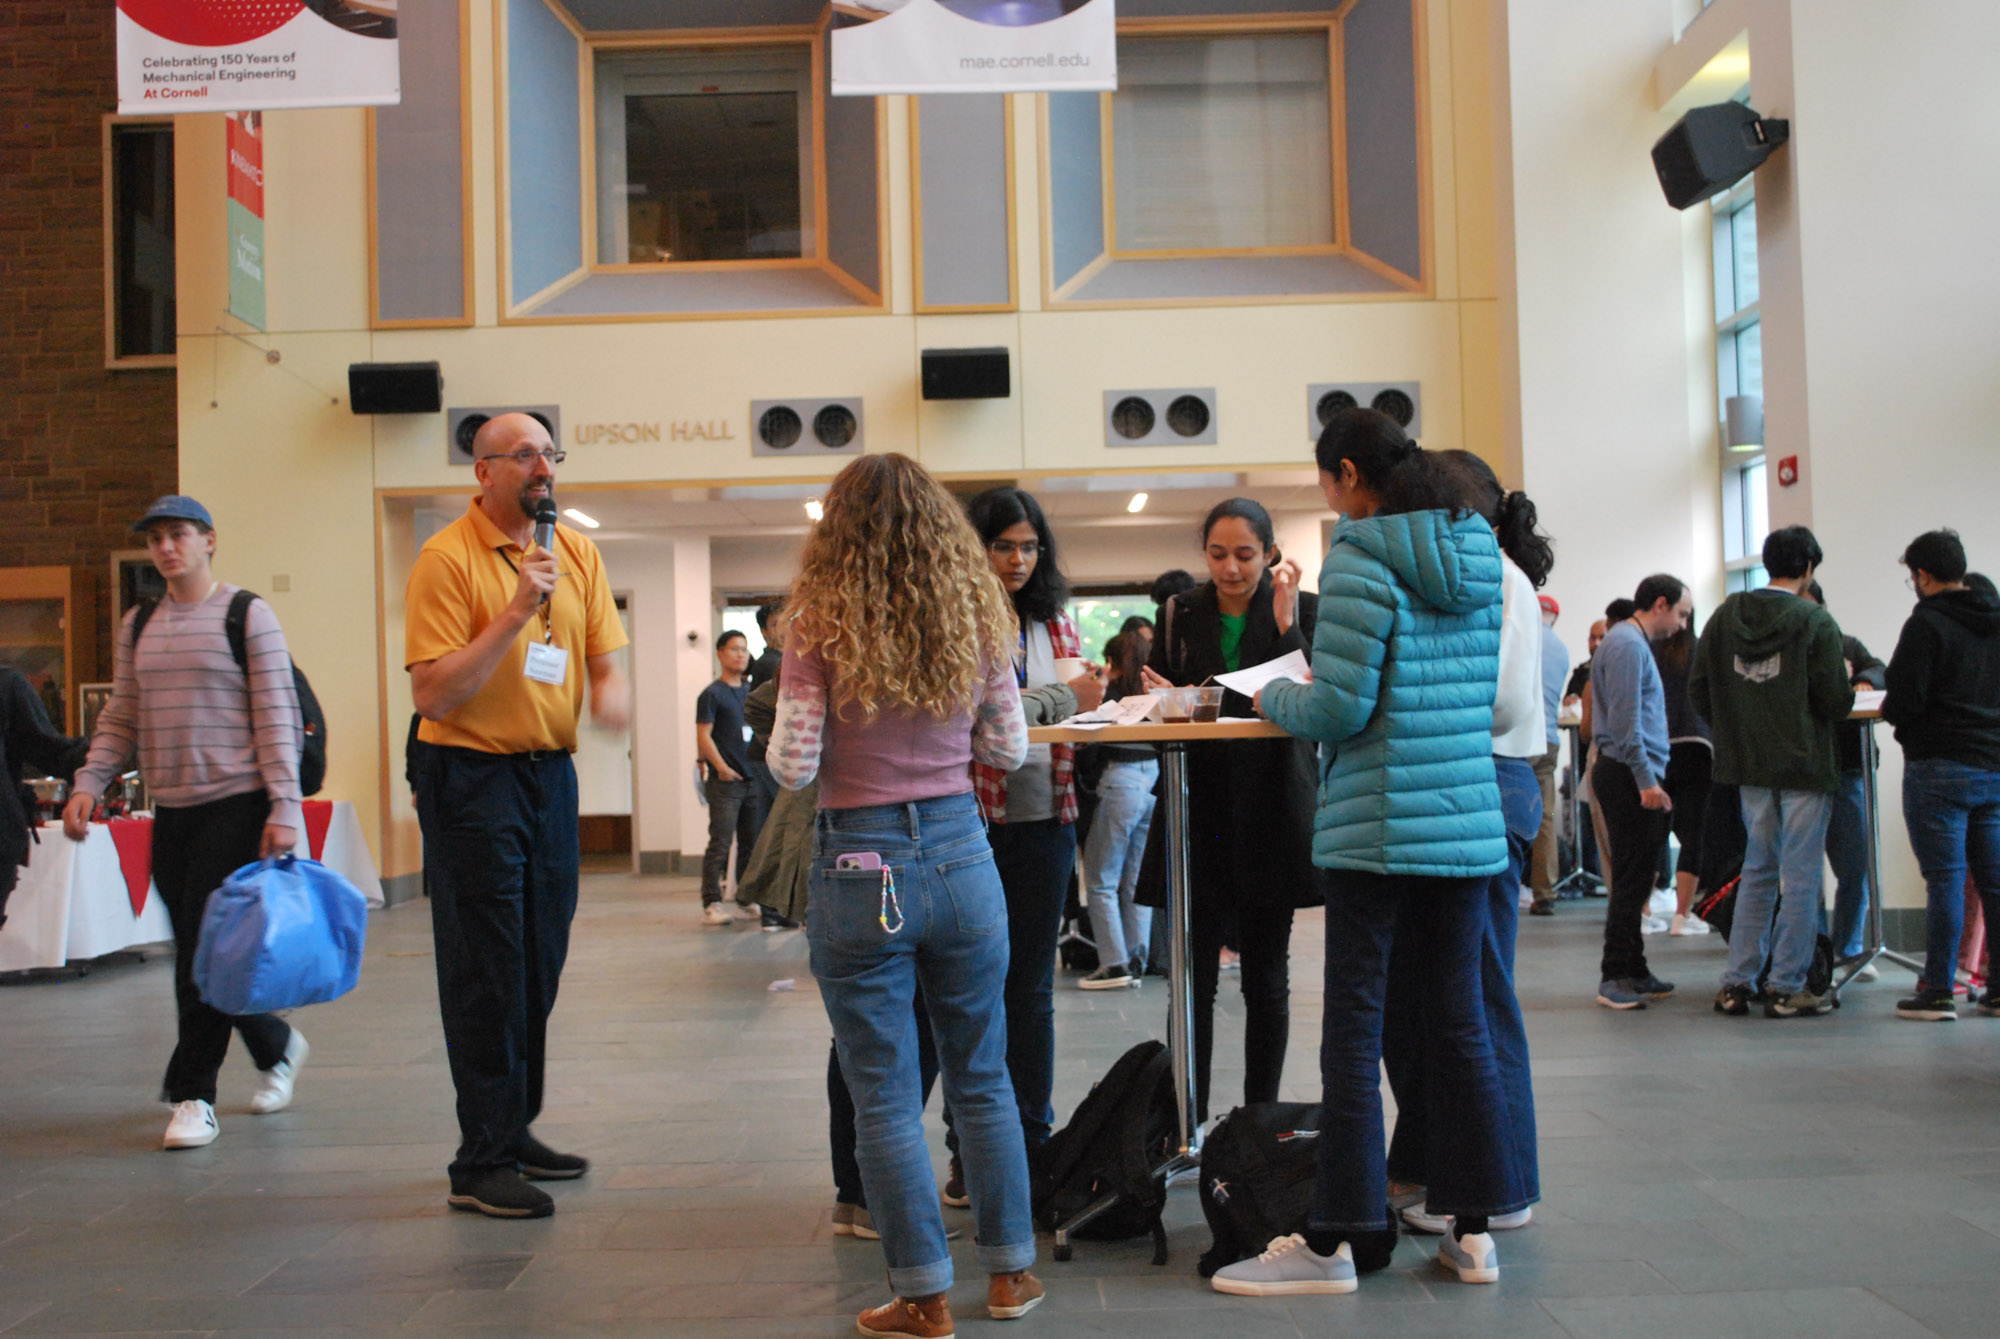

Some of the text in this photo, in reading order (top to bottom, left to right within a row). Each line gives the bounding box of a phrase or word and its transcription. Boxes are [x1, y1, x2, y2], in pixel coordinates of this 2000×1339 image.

[142, 51, 296, 68] Celebrating 150 Years of
[959, 52, 1090, 70] mae.cornell.edu
[143, 67, 297, 84] Mechanical Engineering
[143, 86, 208, 99] At Cornell
[574, 419, 735, 445] UPSON HALL
